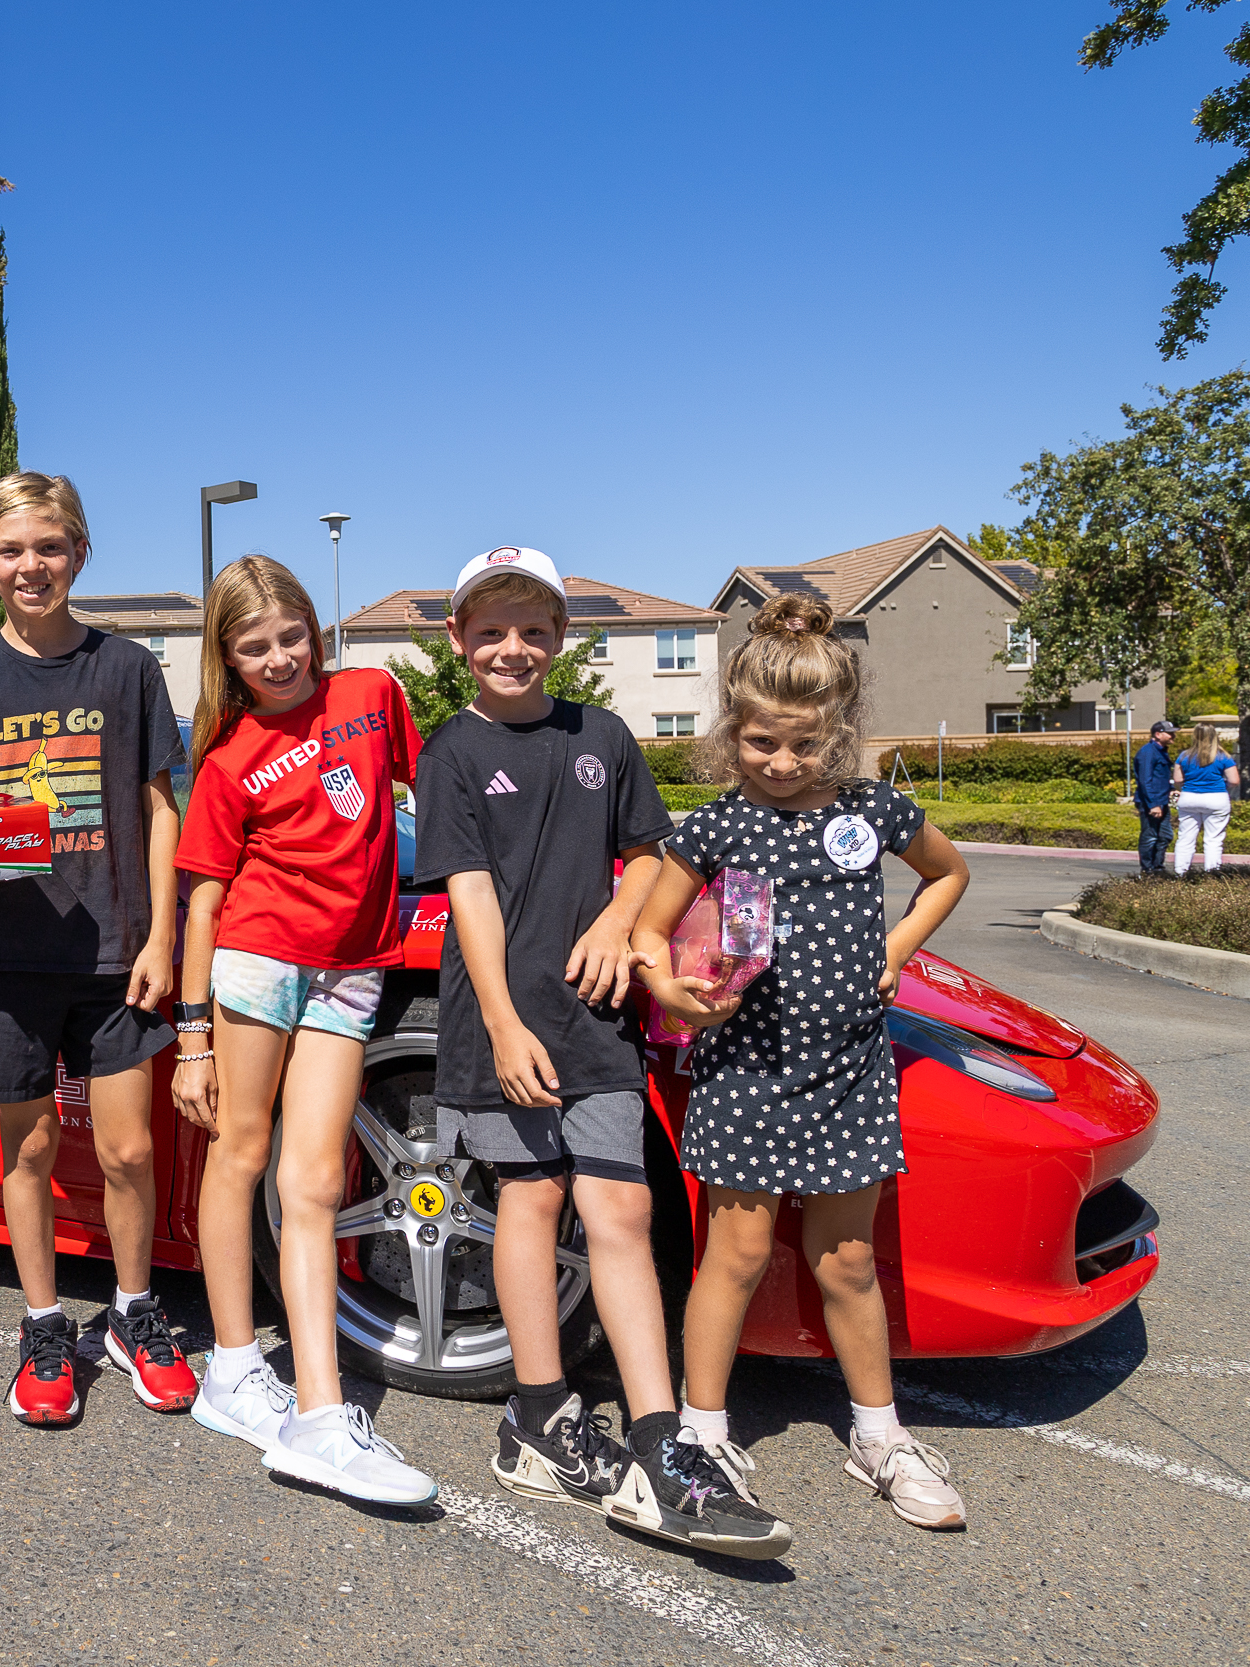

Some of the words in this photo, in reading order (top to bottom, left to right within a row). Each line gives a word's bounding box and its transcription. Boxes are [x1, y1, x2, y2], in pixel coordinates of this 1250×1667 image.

[66, 708, 104, 733] GO
[242, 739, 321, 795] UNITED
[322, 709, 387, 749] STATES
[323, 768, 352, 792] USA
[4, 838, 45, 852] PLAY
[837, 827, 858, 849] WISH
